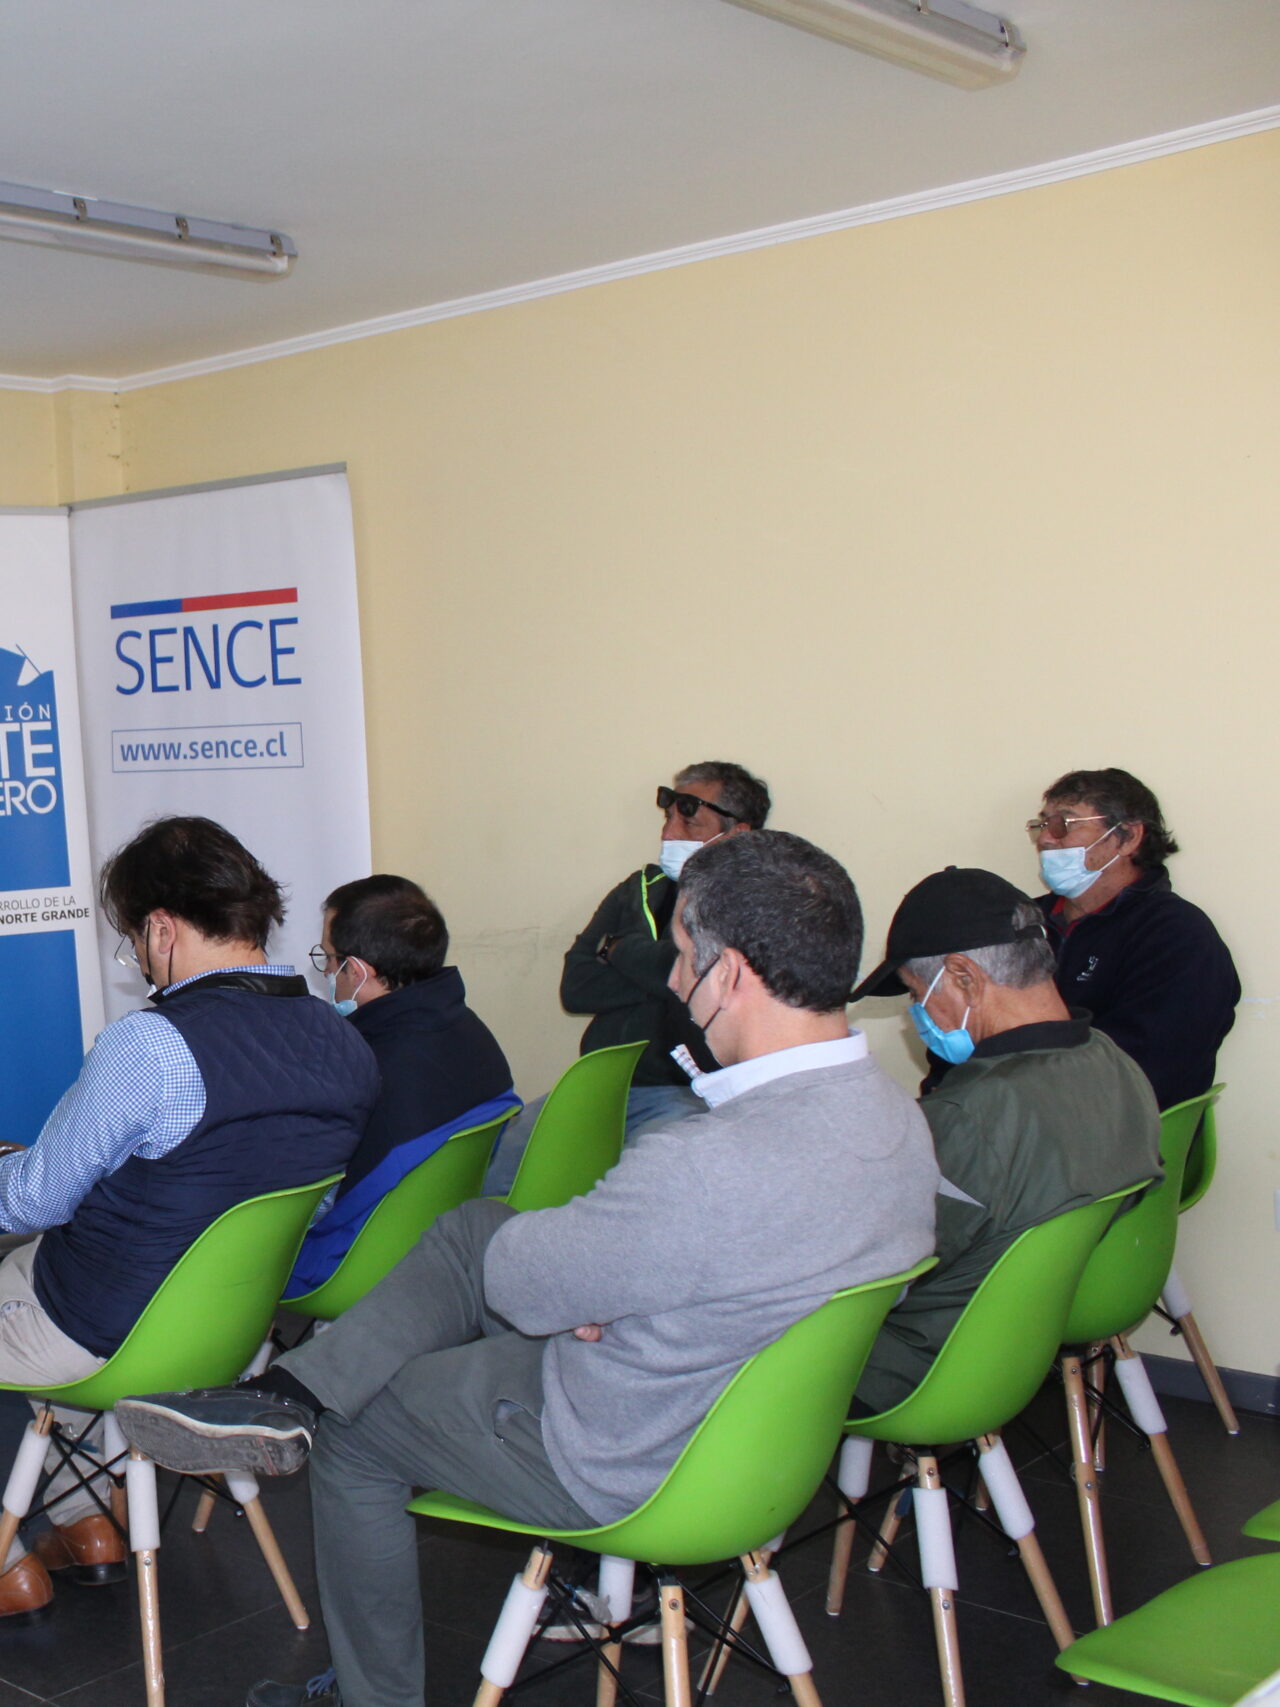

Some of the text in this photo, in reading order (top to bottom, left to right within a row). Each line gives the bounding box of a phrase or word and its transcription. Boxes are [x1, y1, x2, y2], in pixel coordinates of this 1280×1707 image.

[115, 617, 302, 695] SENCE
[120, 731, 287, 761] www.sence.cl
[44, 896, 60, 908] DE
[62, 895, 76, 906] LA
[41, 907, 90, 922] GRANDE
